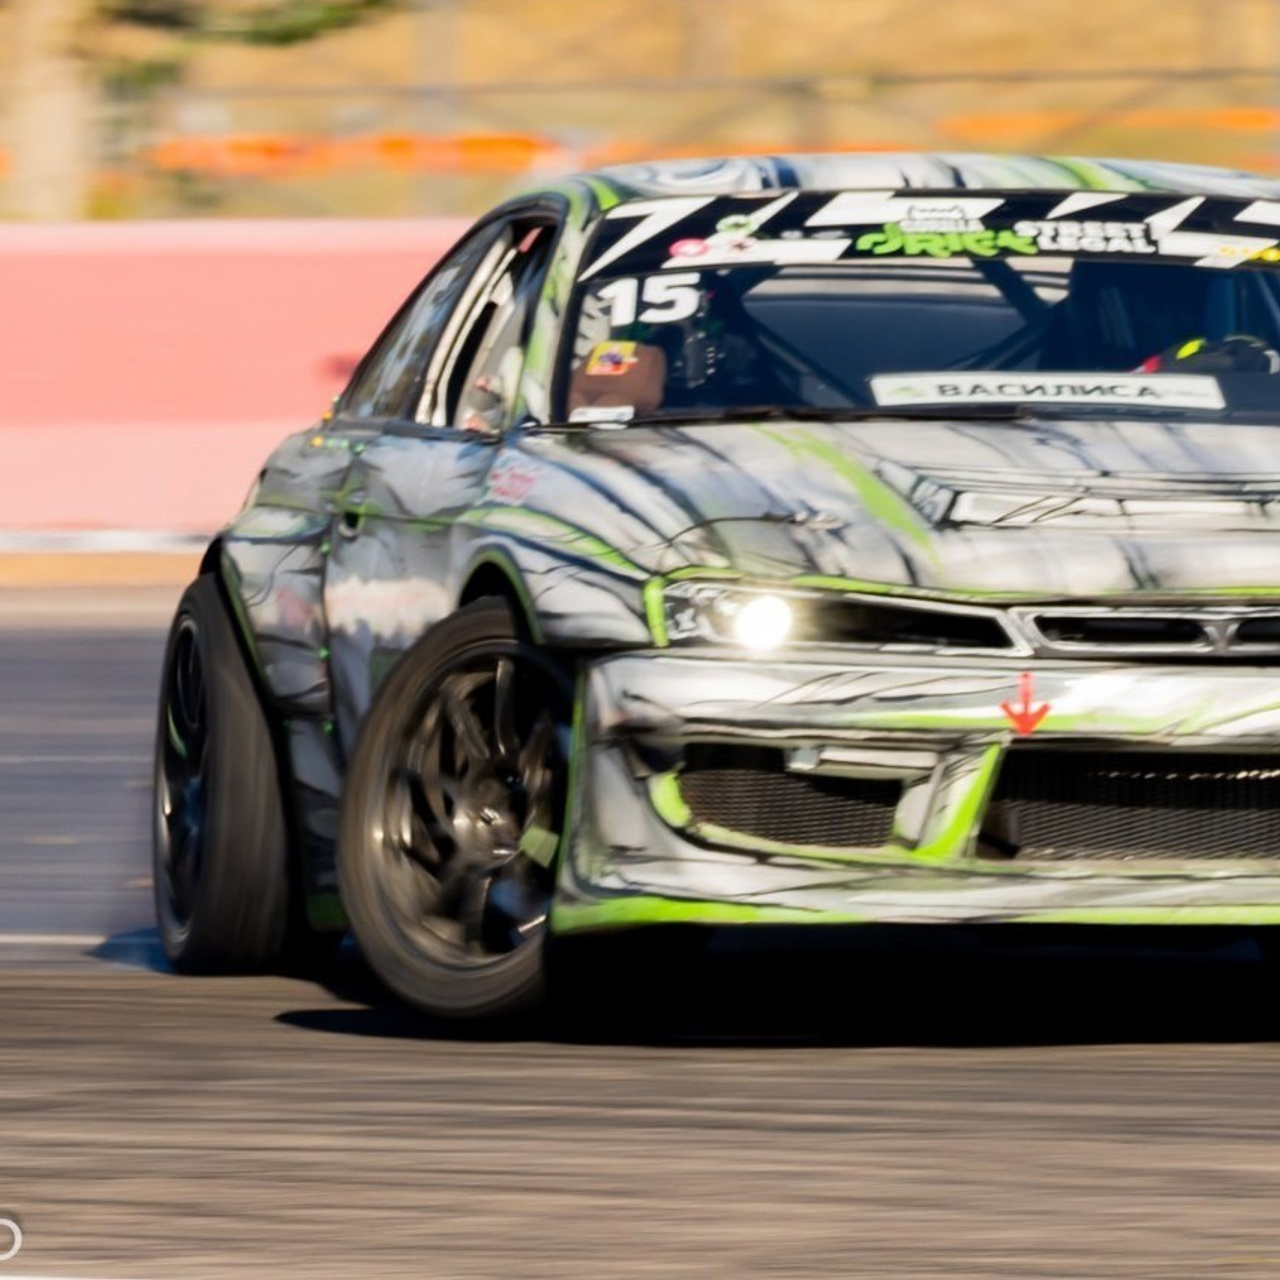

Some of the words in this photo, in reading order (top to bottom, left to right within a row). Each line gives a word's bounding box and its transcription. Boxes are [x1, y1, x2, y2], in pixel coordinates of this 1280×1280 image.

[1013, 220, 1147, 238] STREET
[1036, 236, 1157, 254] LEGAL
[597, 272, 701, 327] 15
[937, 383, 1163, 400] ВАСИЛИСА
